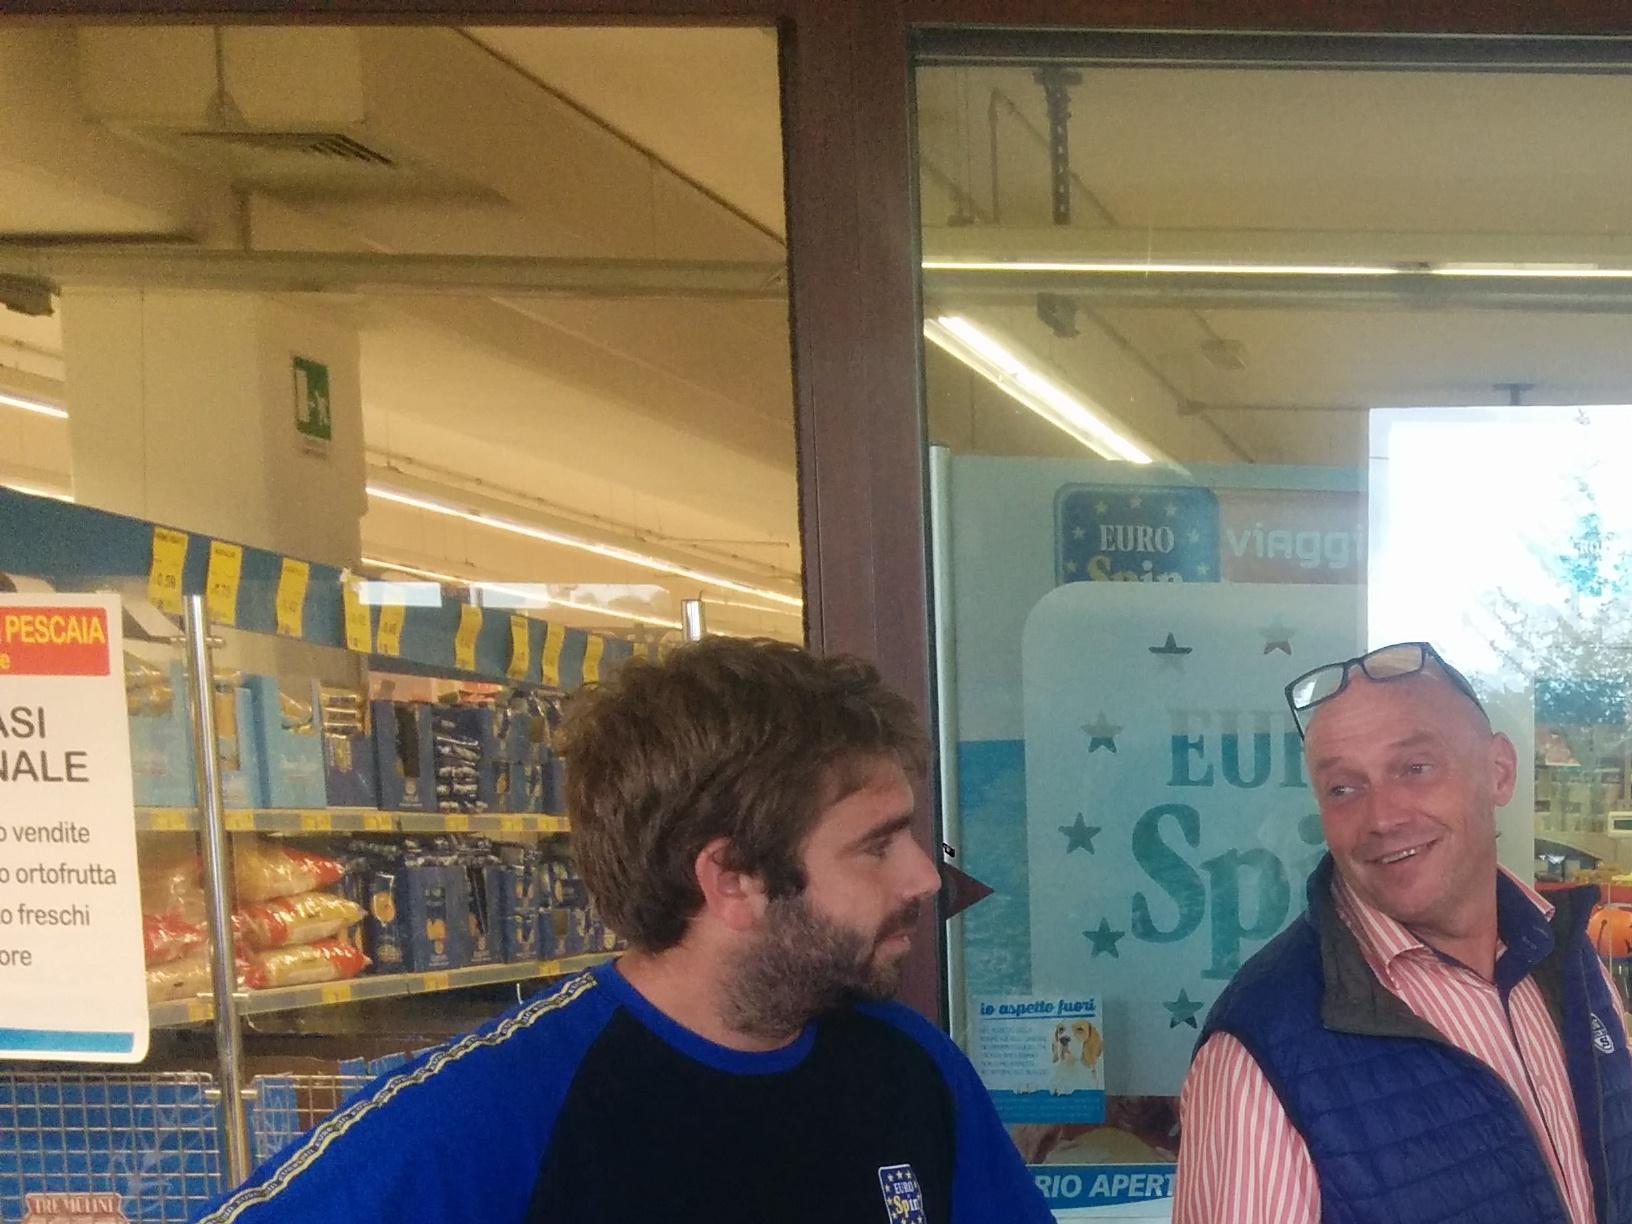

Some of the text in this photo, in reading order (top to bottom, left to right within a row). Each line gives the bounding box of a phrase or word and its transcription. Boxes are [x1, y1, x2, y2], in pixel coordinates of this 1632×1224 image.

[1100, 525, 1174, 553] EURO
[5, 614, 107, 645] PESCAIA
[13, 821, 90, 844] vendite
[16, 862, 117, 885] ortofrutta
[18, 903, 90, 926] freschi
[980, 1002, 995, 1016] io
[1057, 998, 1096, 1015] fuori
[1035, 1173, 1177, 1198] RIO APERT
